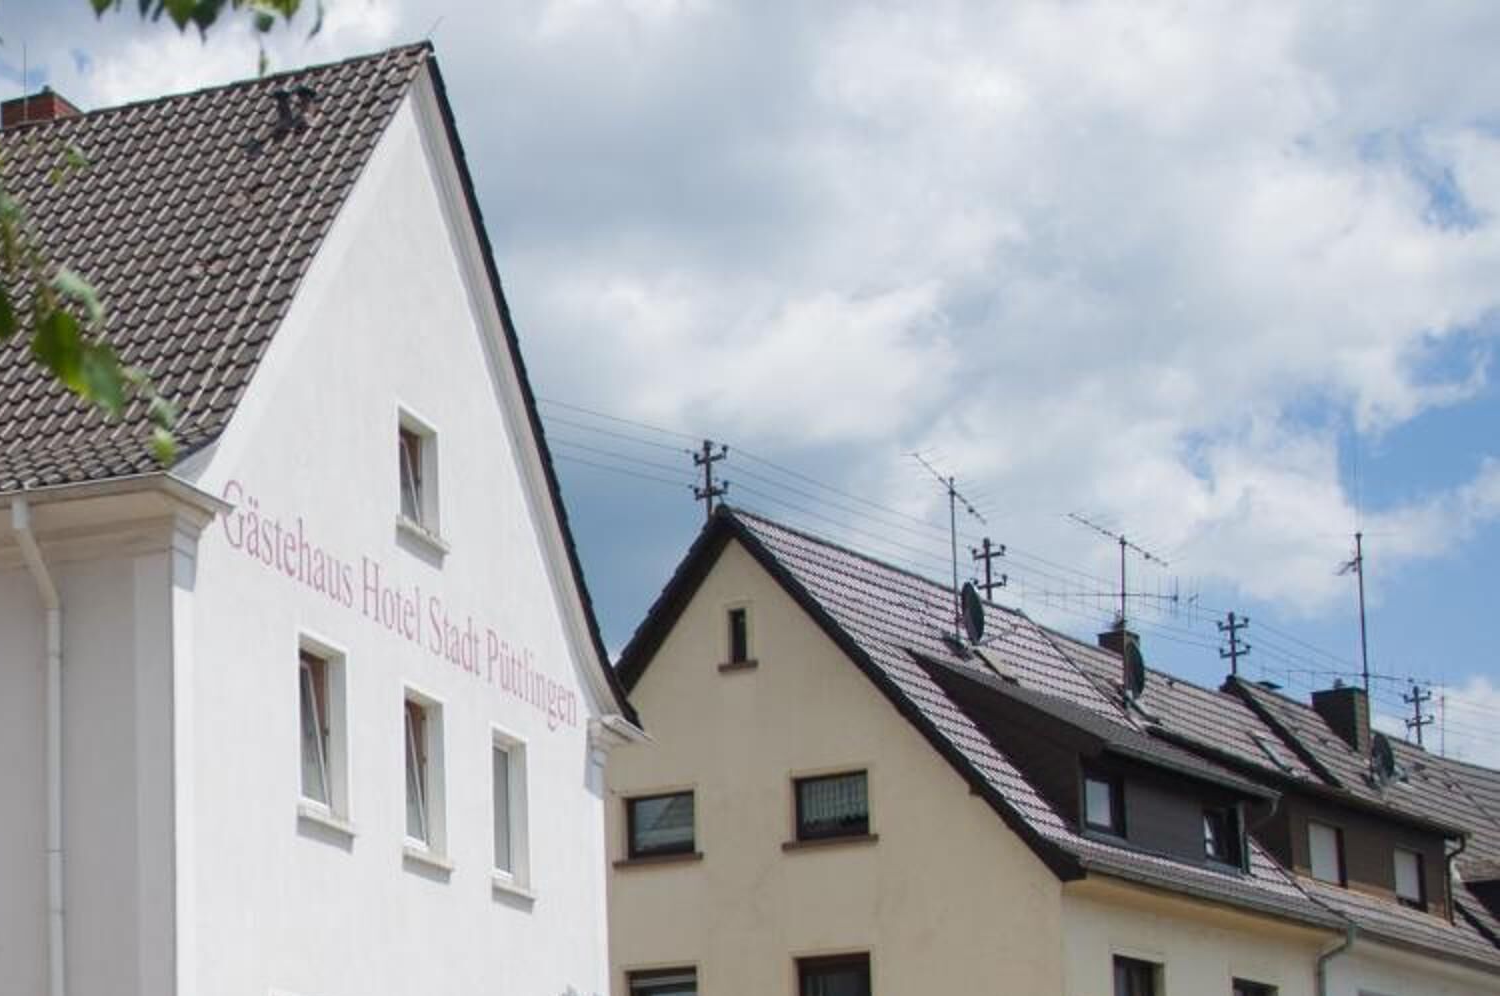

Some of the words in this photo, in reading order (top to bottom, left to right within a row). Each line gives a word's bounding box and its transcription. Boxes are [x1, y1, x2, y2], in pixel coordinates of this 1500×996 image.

[221, 480, 353, 608] Gästehaus
[362, 556, 421, 645] Hotel
[428, 596, 480, 676] Stadt
[487, 629, 577, 731] Püttlingen
